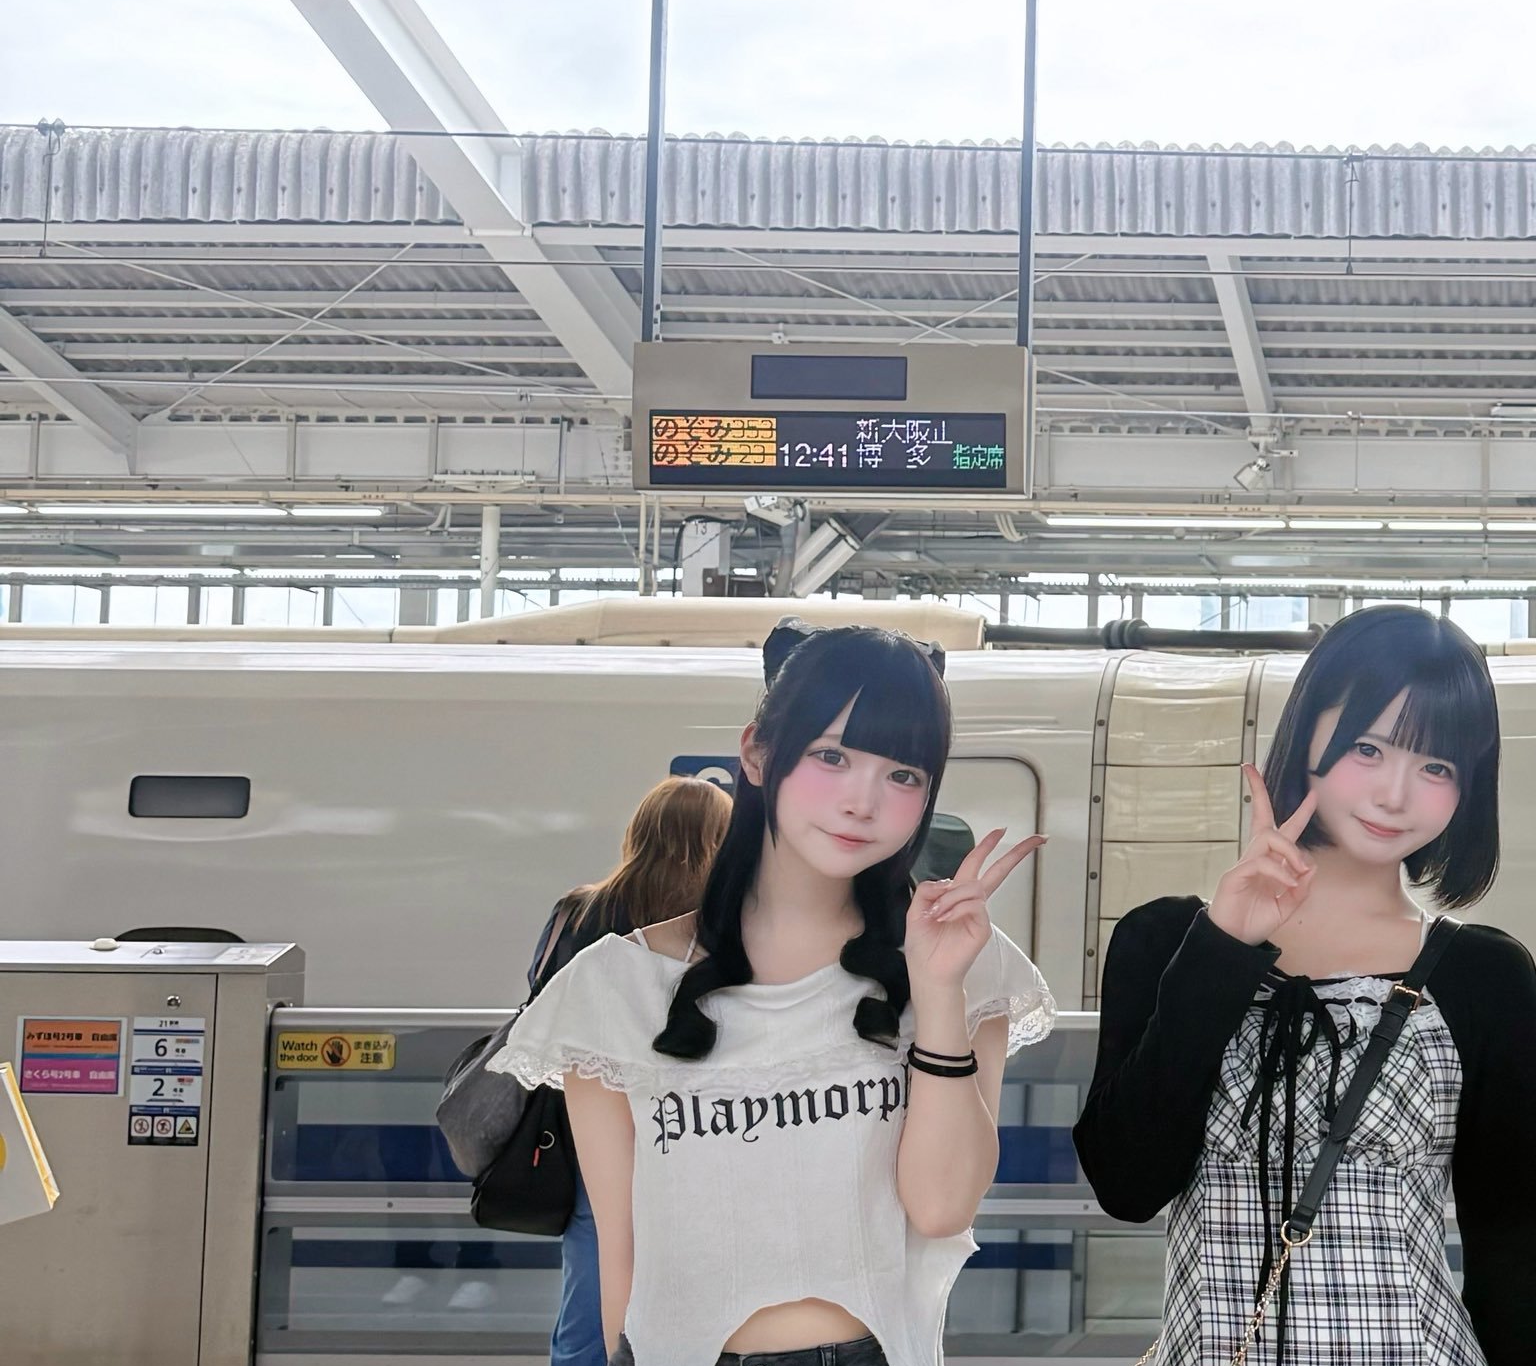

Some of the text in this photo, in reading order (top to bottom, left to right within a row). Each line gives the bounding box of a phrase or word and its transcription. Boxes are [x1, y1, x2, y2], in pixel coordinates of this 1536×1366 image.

[856, 419, 953, 444] 新大阪止
[779, 443, 848, 468] 12:41
[154, 1037, 168, 1057] 6
[282, 1040, 318, 1051] Watch
[279, 1053, 319, 1062] the door
[152, 1078, 165, 1096] 2
